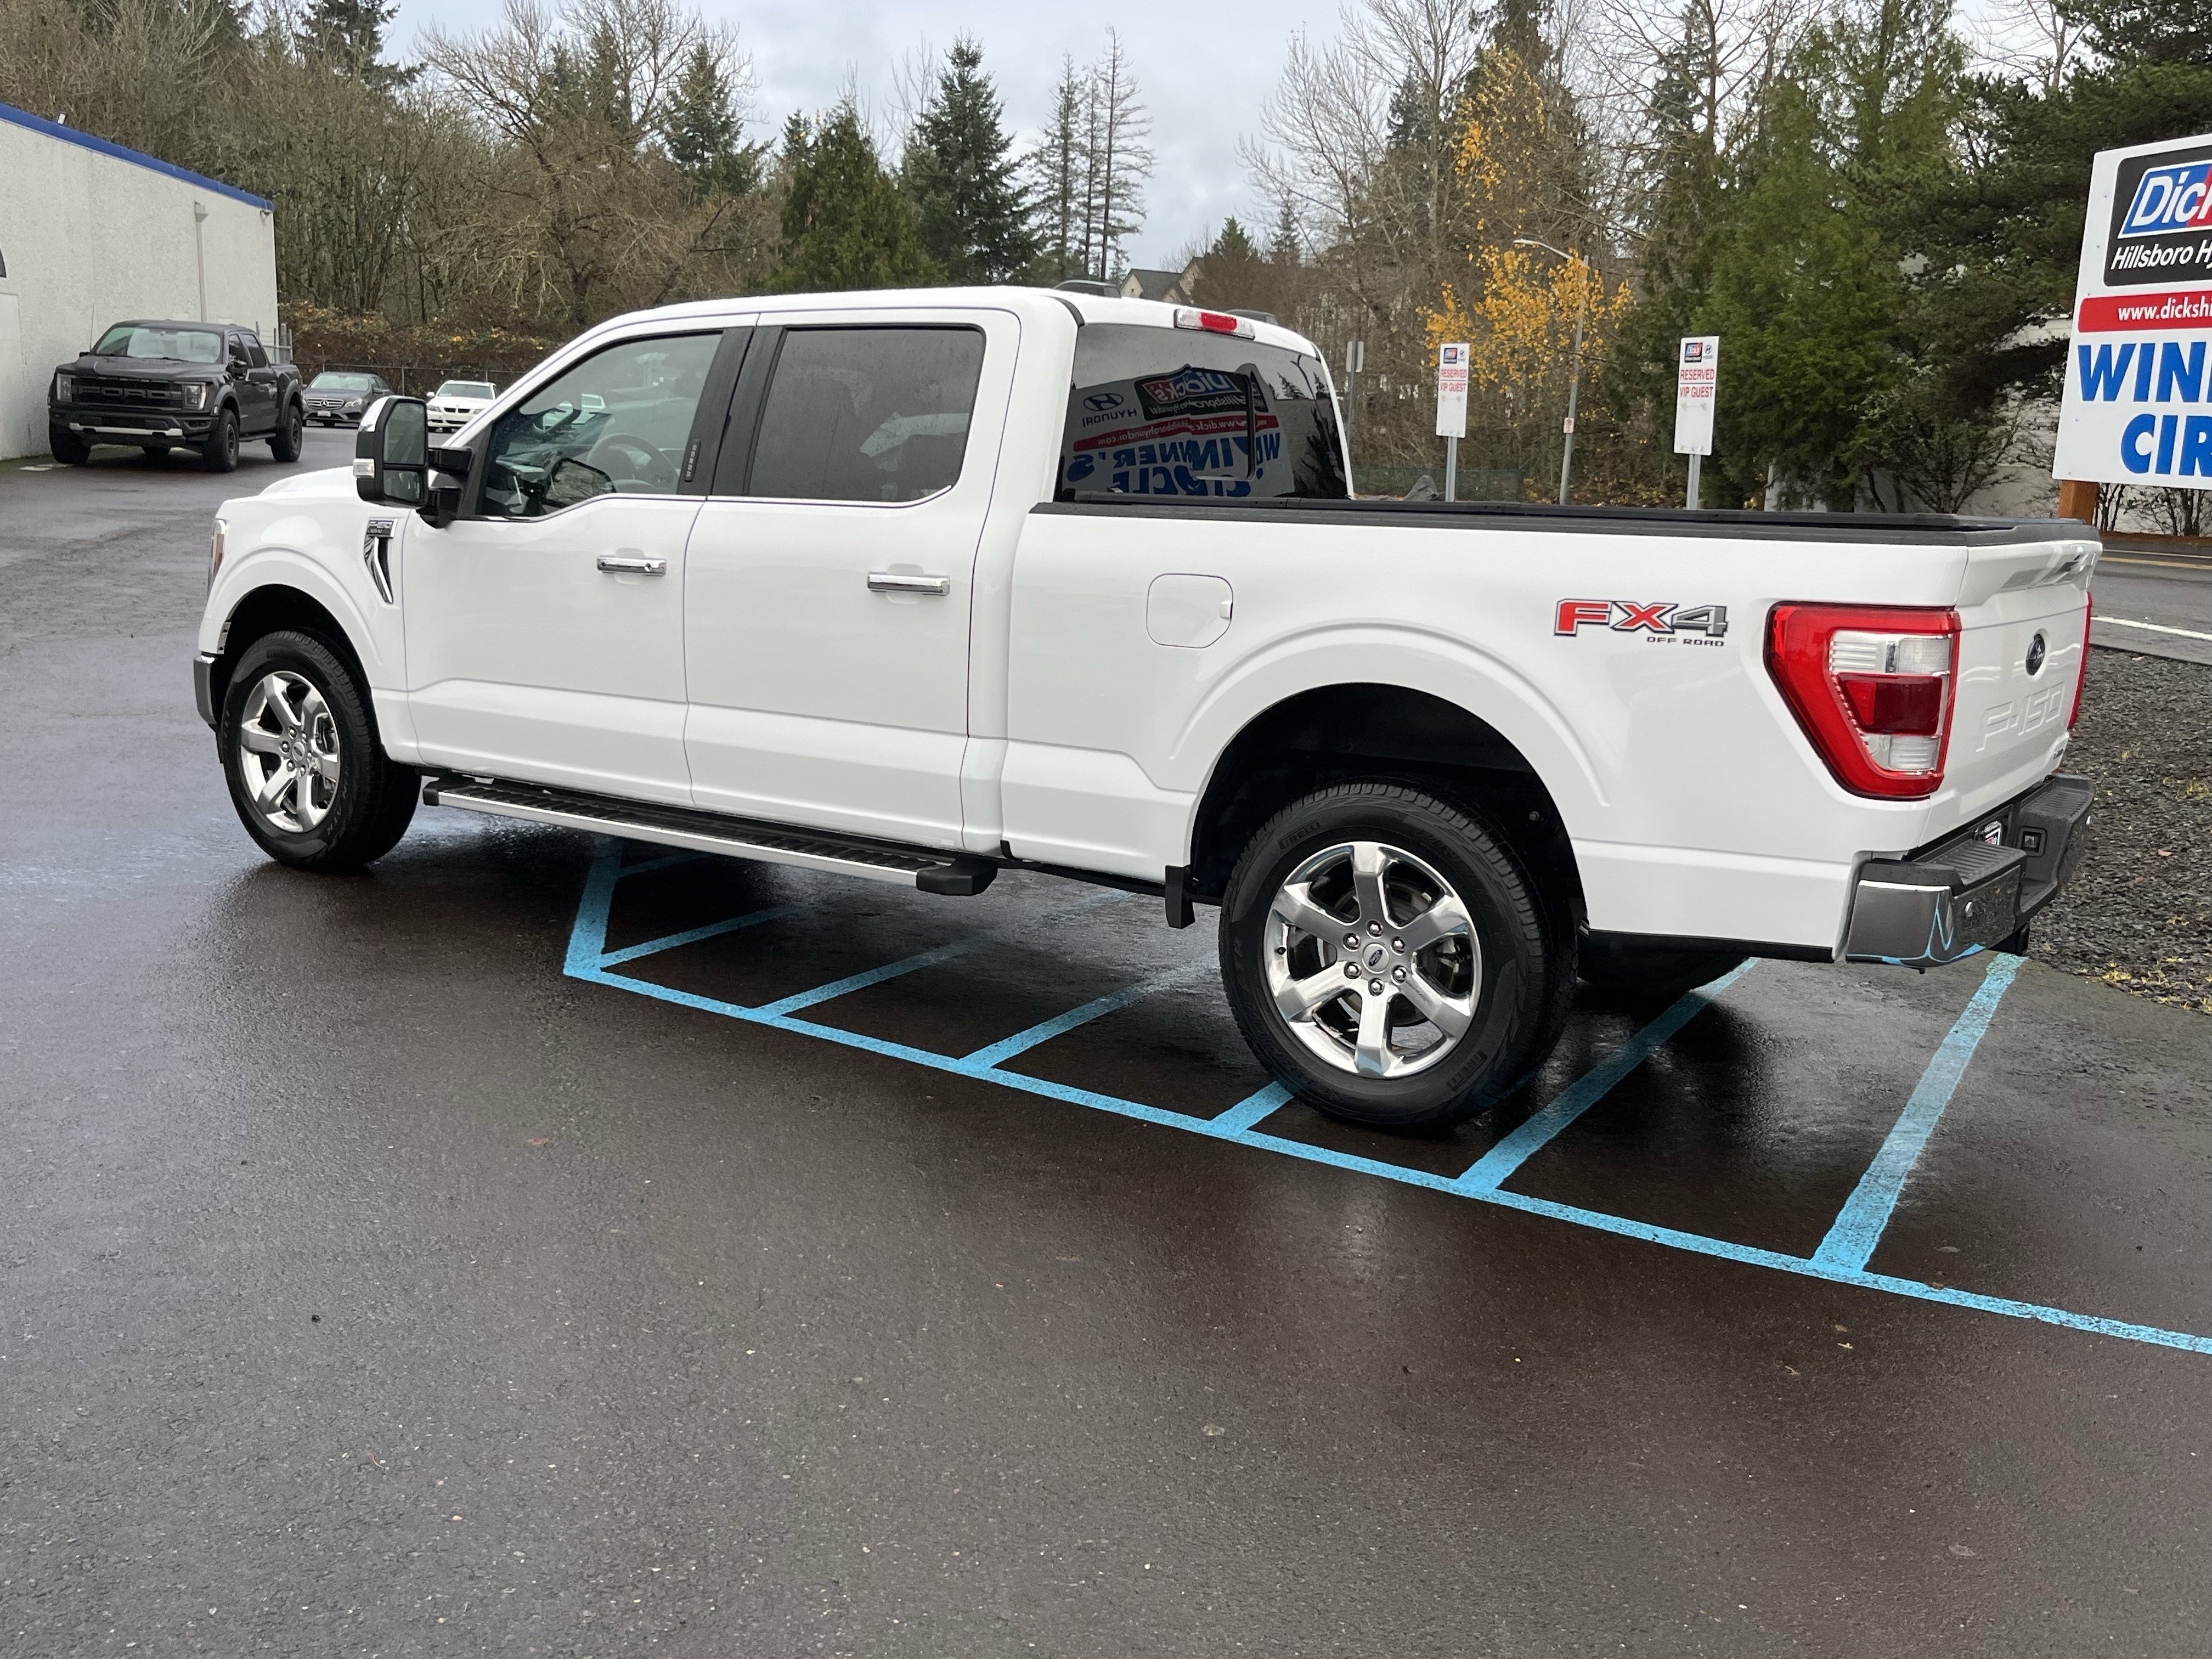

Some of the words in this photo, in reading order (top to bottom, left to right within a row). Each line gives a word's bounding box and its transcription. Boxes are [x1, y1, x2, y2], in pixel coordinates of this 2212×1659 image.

[2111, 243, 2193, 270] Hillsboro
[2195, 239, 2212, 269] H
[1440, 369, 1467, 378] RESERVED
[1680, 369, 1714, 381] RESERVED
[2078, 341, 2212, 403] WIN
[79, 385, 172, 400] FORD
[1449, 382, 1466, 392] GUEST
[1679, 386, 1690, 397] VIP
[1691, 386, 1713, 398] GUEST
[1554, 599, 1728, 637] FX4
[1683, 639, 1725, 647] ROAD
